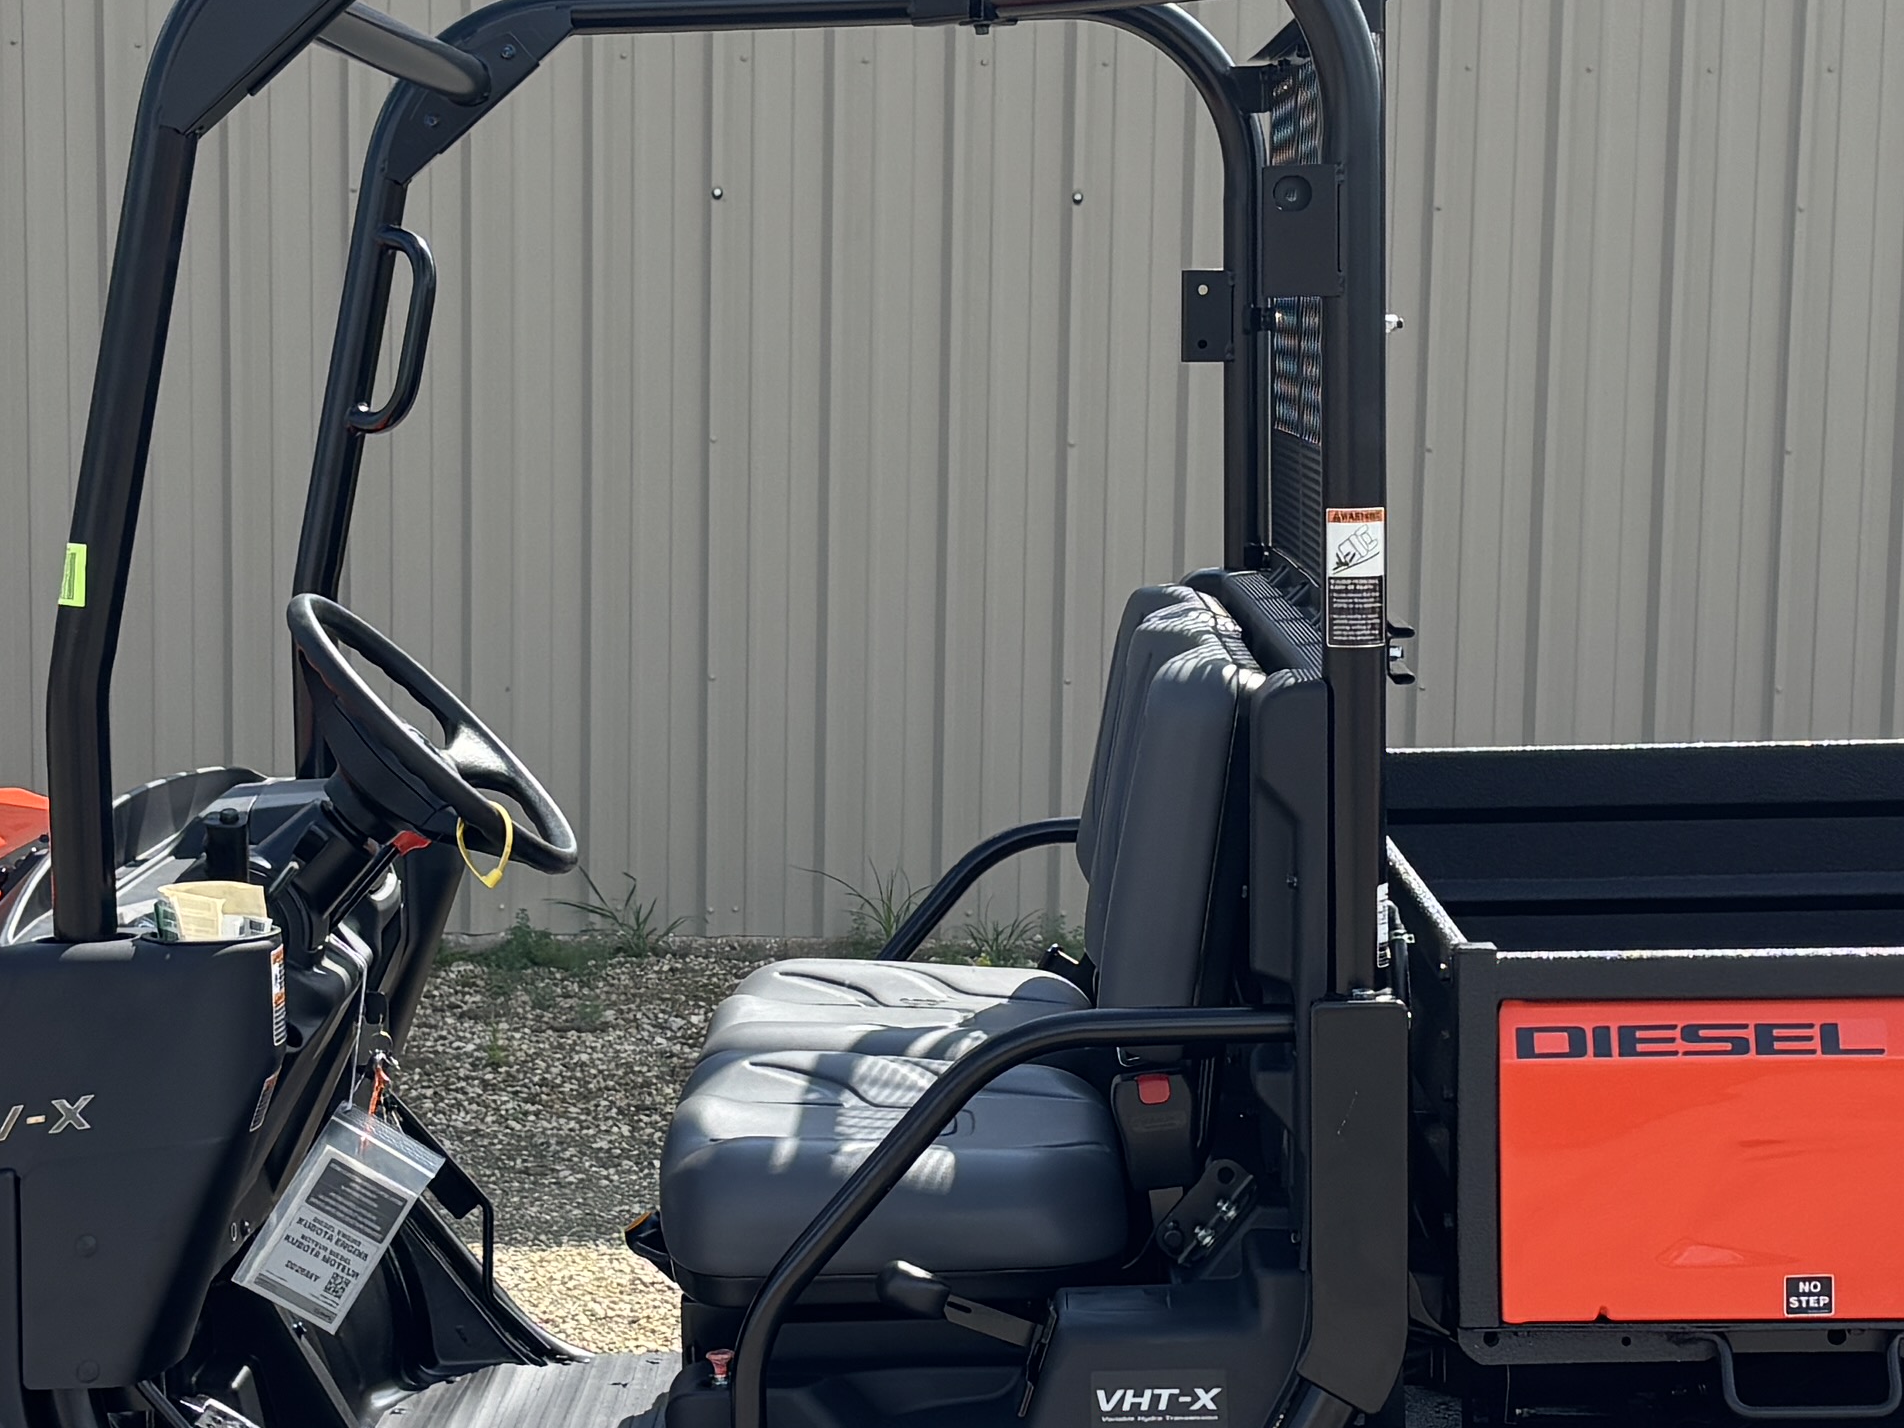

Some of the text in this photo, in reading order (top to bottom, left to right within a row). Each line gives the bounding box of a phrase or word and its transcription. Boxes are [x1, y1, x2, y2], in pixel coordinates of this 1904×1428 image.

[1515, 1022, 1886, 1059] DIESEL
[1798, 1280, 1822, 1293] NO
[1789, 1296, 1830, 1308] STEP
[1096, 1388, 1222, 1412] VHT-X
